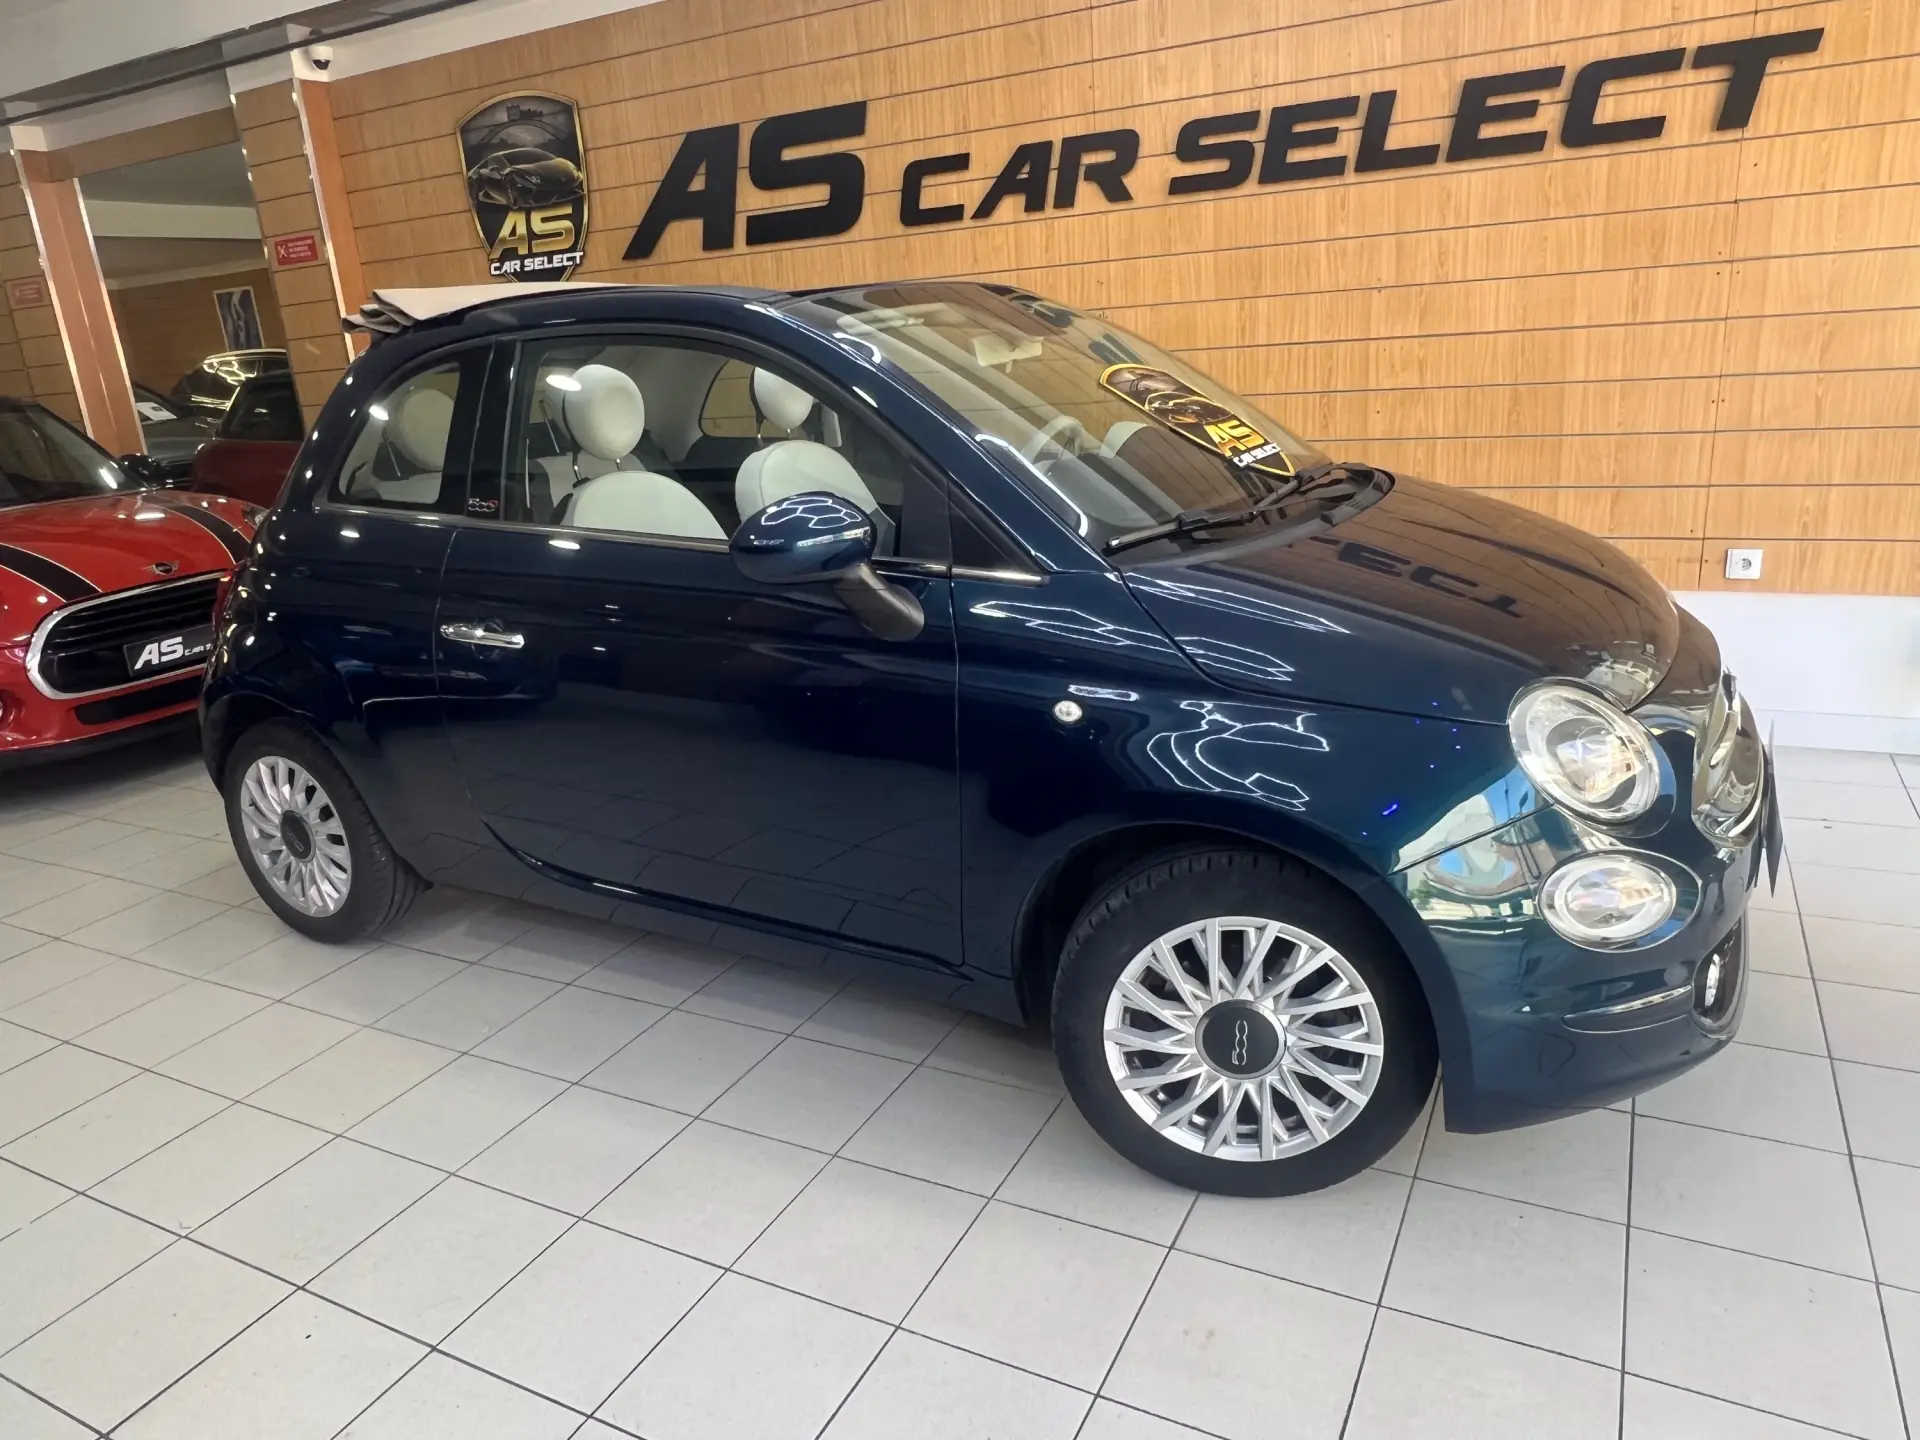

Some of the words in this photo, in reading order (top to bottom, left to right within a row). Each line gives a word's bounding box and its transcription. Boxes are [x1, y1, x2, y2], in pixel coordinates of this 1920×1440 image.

[622, 101, 867, 261] AS
[900, 129, 1140, 226] CAR
[1168, 28, 1825, 195] SELECT
[488, 204, 575, 261] AS
[490, 260, 521, 275] CAR
[524, 252, 584, 271] SELECT
[1203, 419, 1265, 457] AS
[134, 636, 183, 670] AS
